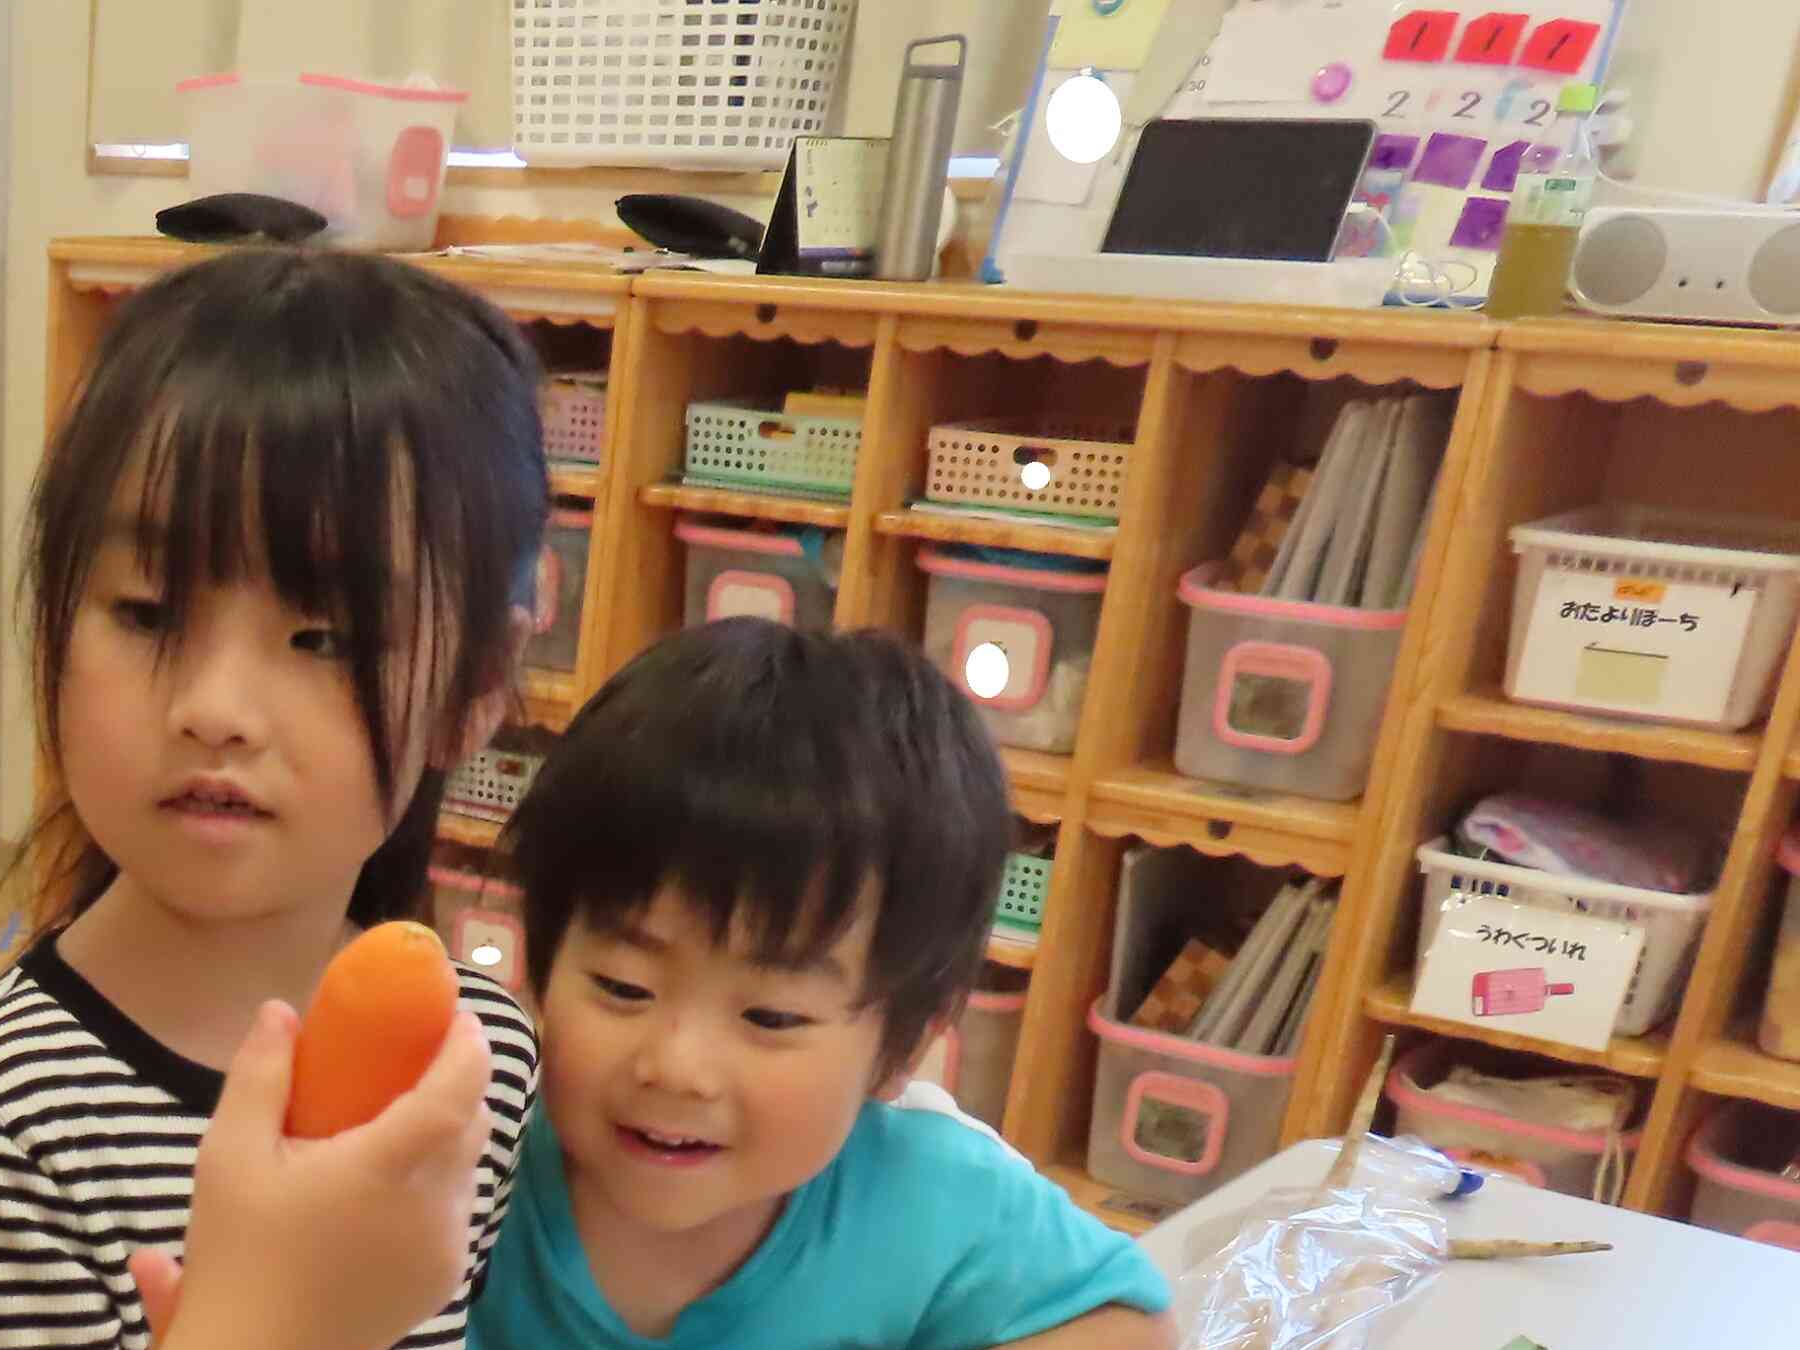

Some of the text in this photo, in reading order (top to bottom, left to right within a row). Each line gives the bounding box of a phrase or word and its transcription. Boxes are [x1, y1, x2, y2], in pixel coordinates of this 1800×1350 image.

[1381, 90, 1551, 126] 2 2 2
